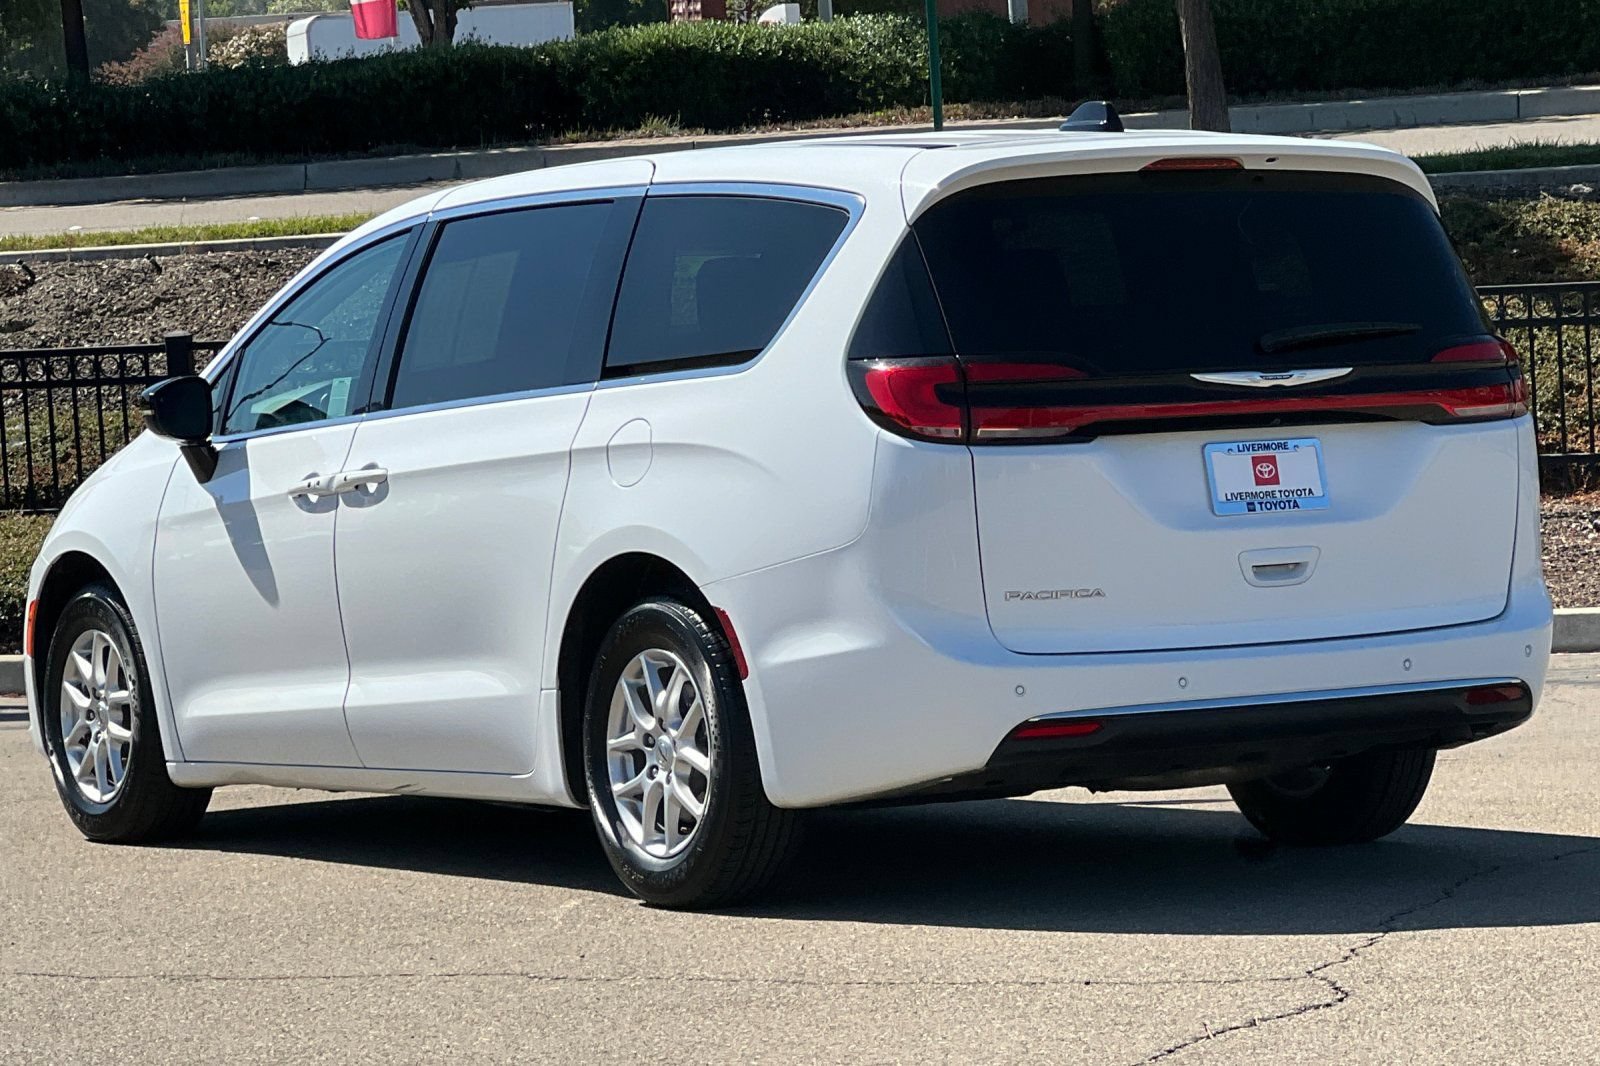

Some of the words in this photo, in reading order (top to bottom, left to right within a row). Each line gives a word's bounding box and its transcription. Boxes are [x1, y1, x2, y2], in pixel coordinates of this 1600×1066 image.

[1237, 442, 1288, 453] LIVERMORE
[1225, 490, 1276, 502] LIVERMORE
[1278, 488, 1314, 498] TOYOTA
[1259, 500, 1300, 511] TOYOTA
[1004, 588, 1106, 601] PACIFICA
